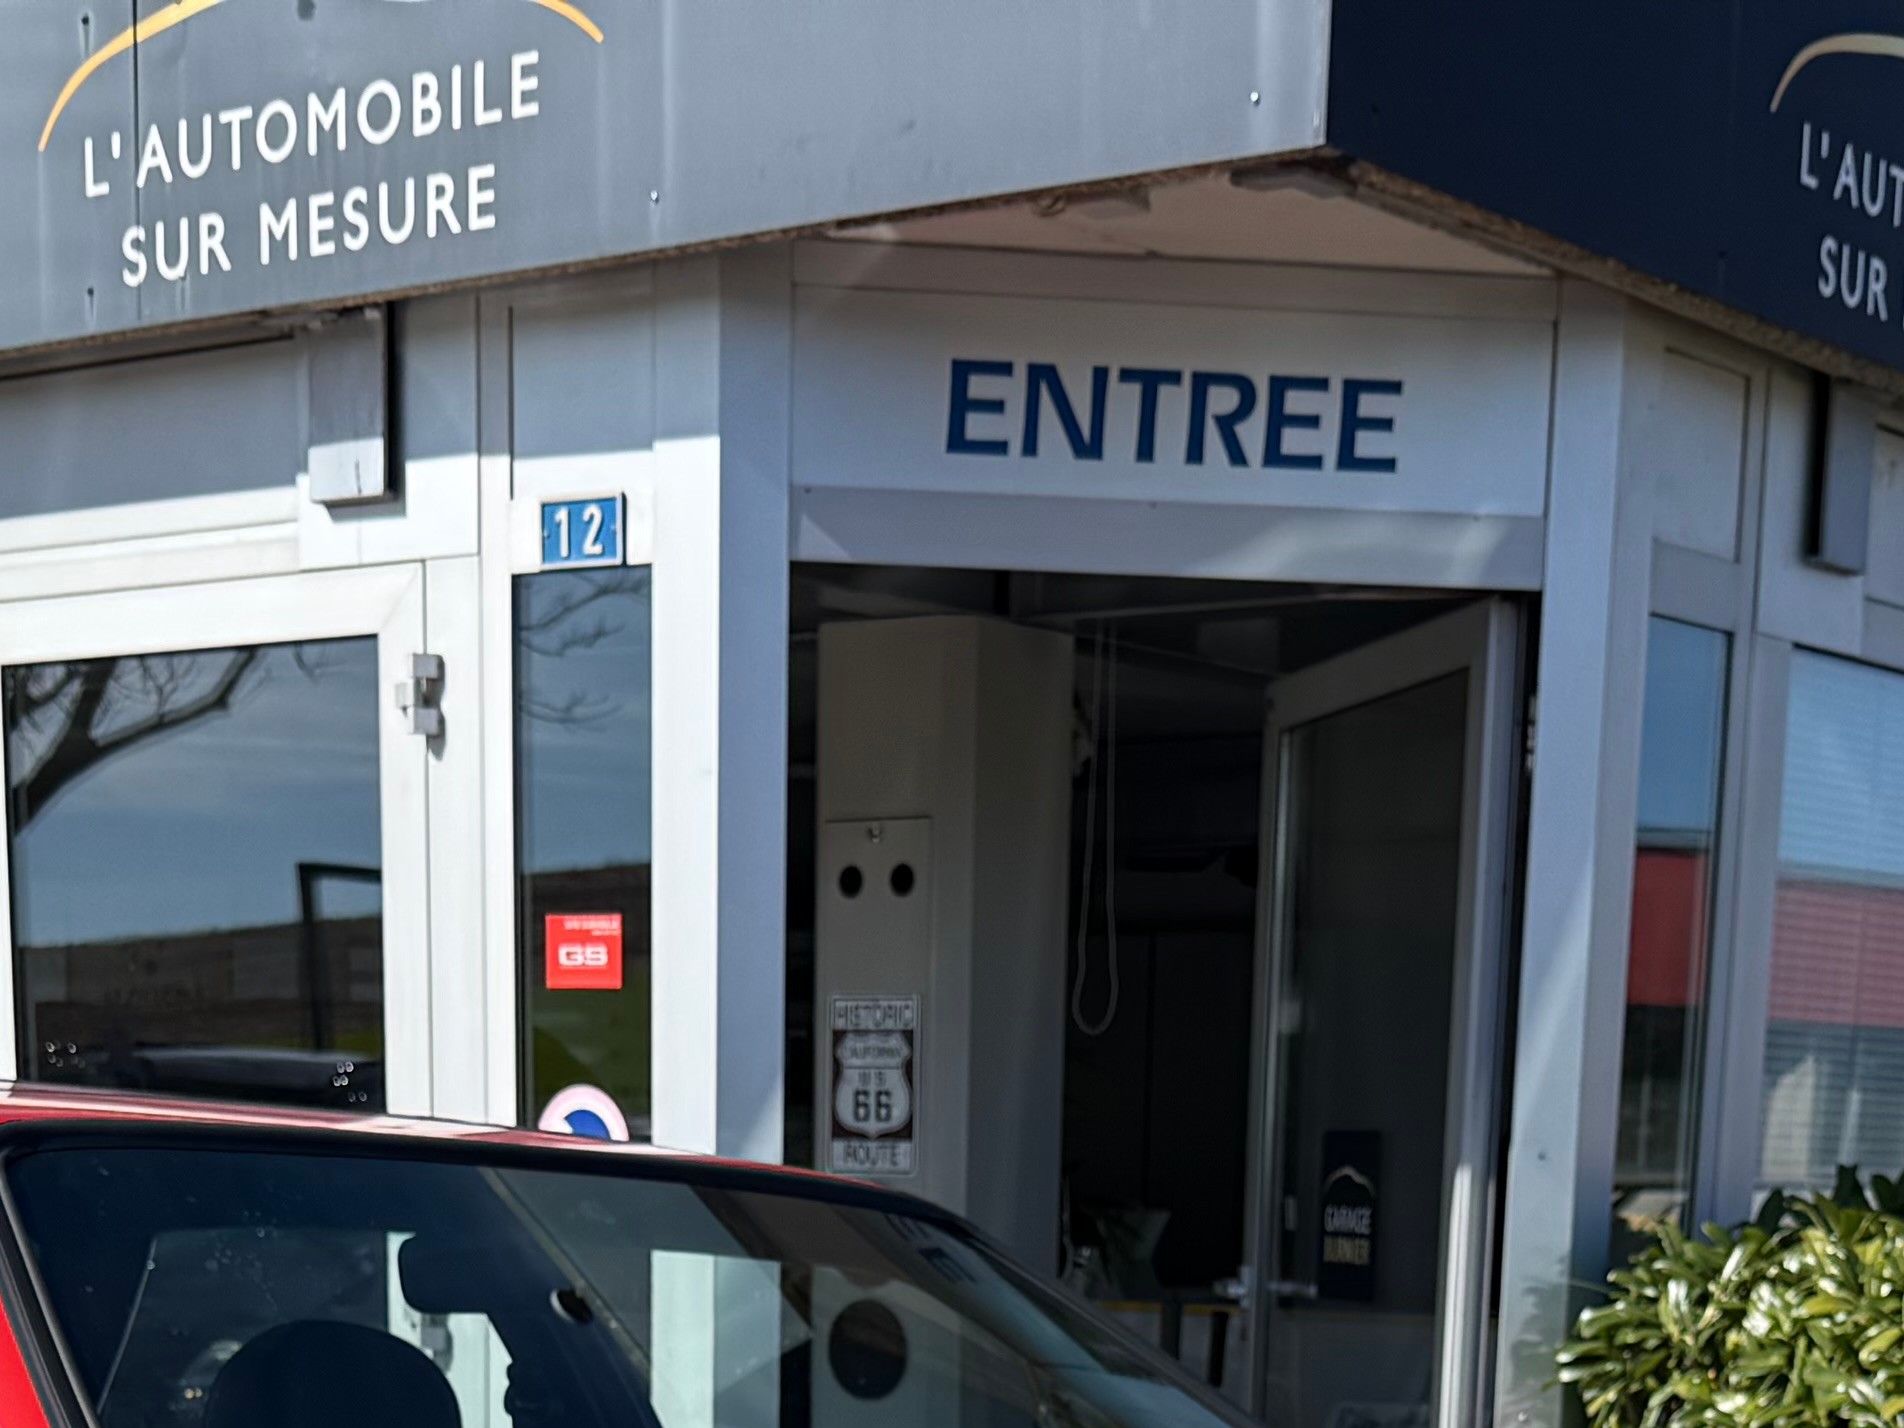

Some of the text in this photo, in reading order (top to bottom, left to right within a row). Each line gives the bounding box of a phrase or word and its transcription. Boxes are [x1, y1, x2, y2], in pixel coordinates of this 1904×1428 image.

[82, 50, 541, 198] L'AUTOMOBILE
[120, 165, 497, 288] SUR MESURE
[1818, 235, 1889, 322] SUR
[945, 356, 1404, 474] ENTREE
[551, 504, 607, 556] 12
[853, 1088, 893, 1123] 66
[843, 1141, 900, 1168] ROUTE
